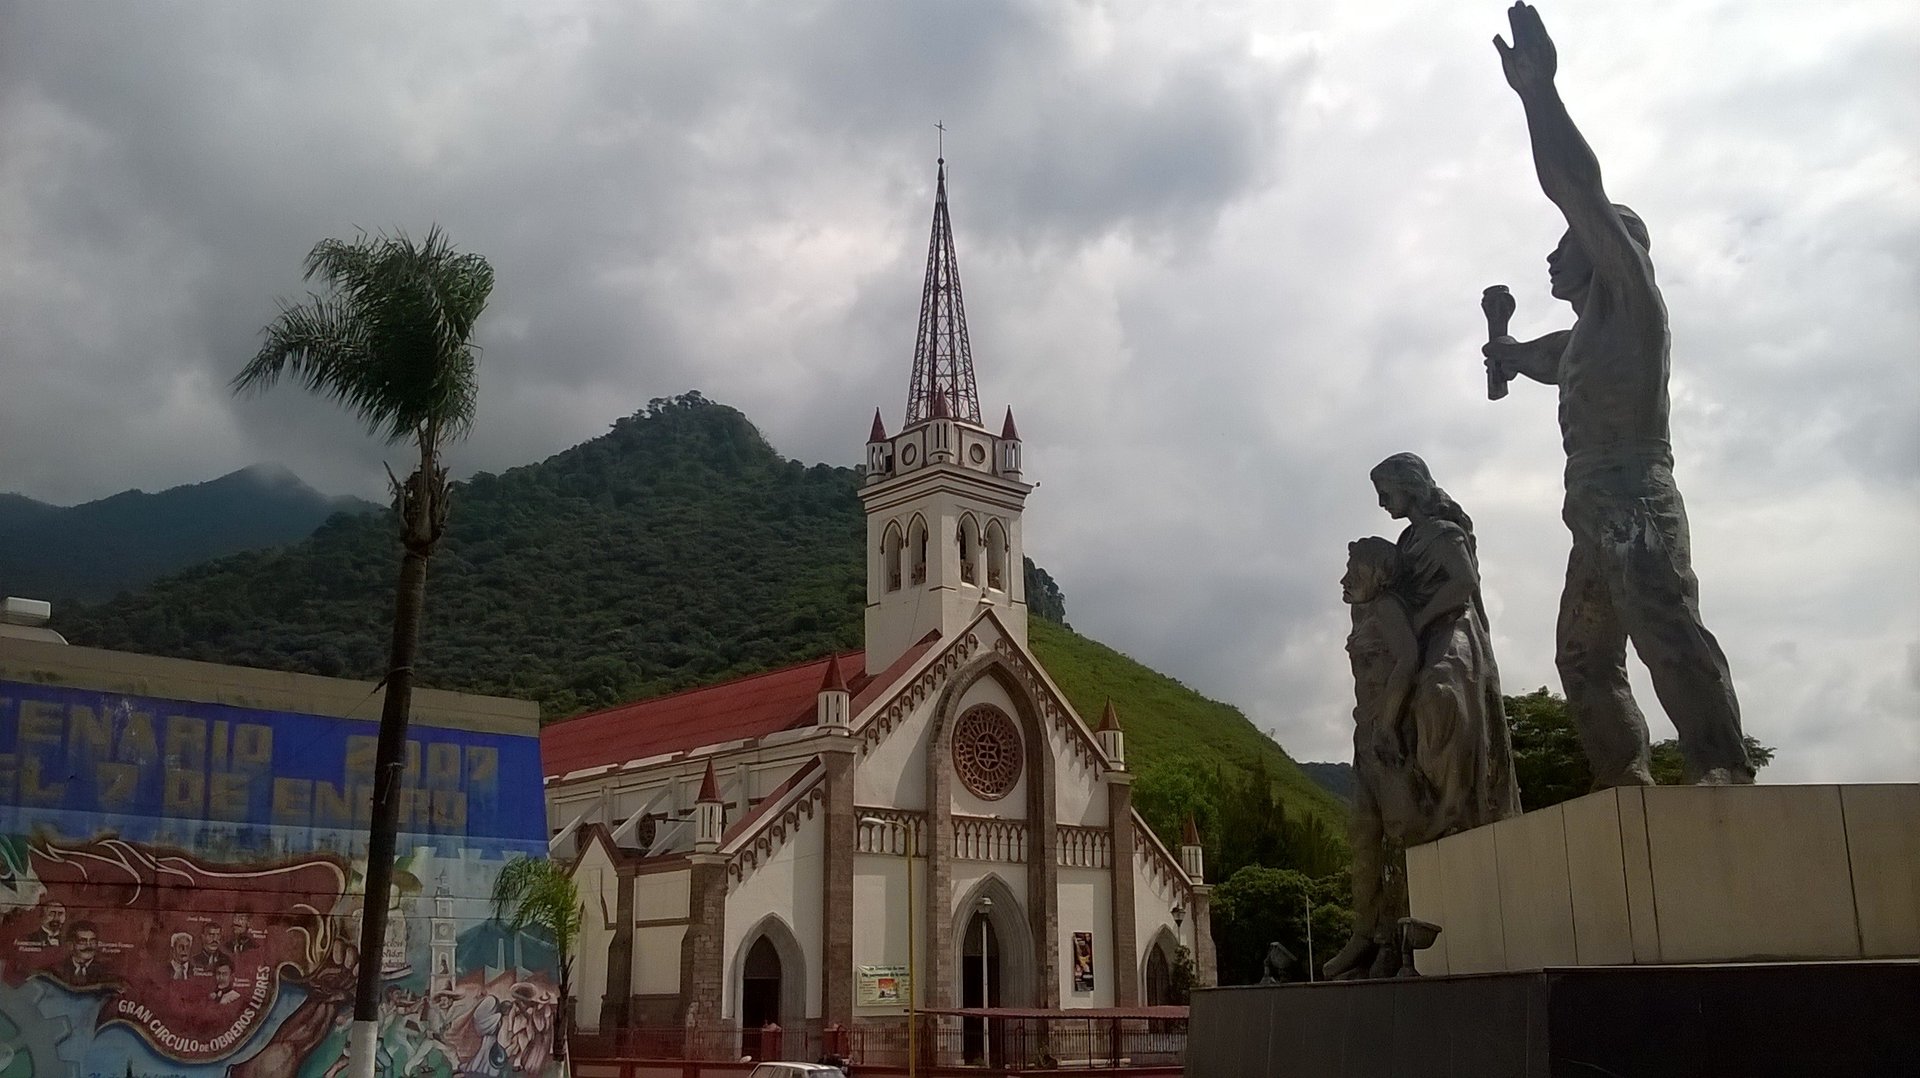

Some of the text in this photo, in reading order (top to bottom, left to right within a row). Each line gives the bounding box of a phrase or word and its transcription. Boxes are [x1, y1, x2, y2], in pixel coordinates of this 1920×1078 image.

[0, 698, 273, 766] ENARIO
[97, 762, 138, 803] 7
[164, 767, 249, 815] DE
[118, 999, 153, 1023] GRAN
[149, 1019, 199, 1052] CIRCULO
[210, 1008, 255, 1051] OBREROS
[252, 965, 271, 1010] LIBRES
